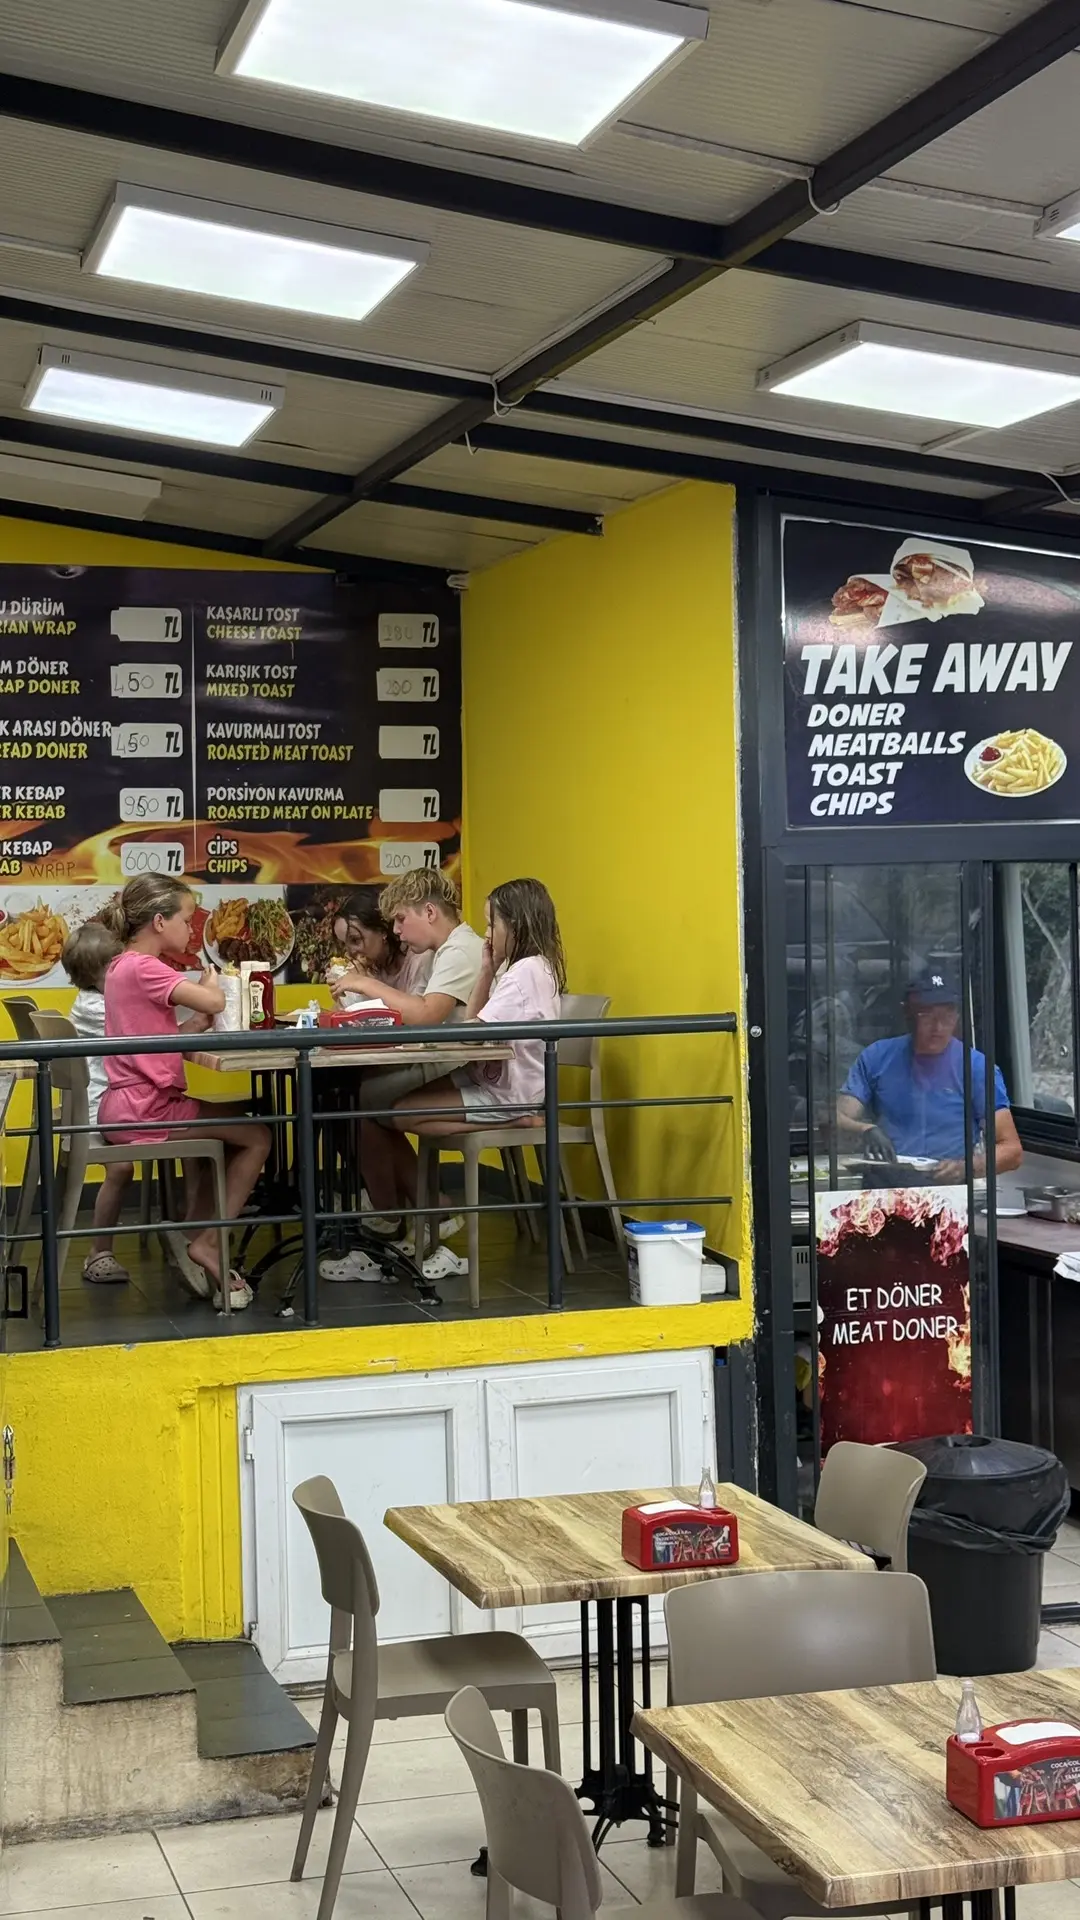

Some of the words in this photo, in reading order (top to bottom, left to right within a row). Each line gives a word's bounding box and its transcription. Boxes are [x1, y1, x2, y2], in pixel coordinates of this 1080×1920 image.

[10, 597, 65, 616] DÜRÜM
[207, 606, 263, 624] KAŞARLI
[266, 607, 300, 621] TOST
[32, 621, 77, 635] WRAP
[164, 616, 179, 638] TL
[207, 625, 256, 639] CHEESE
[260, 626, 302, 640] TOAST
[422, 622, 437, 643] TL
[16, 656, 69, 675] DÖNER
[206, 664, 260, 682] KARIŞIK
[263, 665, 298, 679] TOST
[800, 643, 929, 696] TAKE
[932, 641, 1074, 693] AWAY
[28, 679, 81, 694] DONER
[165, 672, 180, 694] TL
[206, 683, 250, 697] MIXED
[252, 683, 295, 698] TOAST
[422, 676, 437, 698] TL
[807, 702, 906, 728] DONER
[12, 720, 57, 737] ARASI
[60, 716, 112, 738] DÖNER
[206, 722, 285, 739] KAVURMALI
[287, 723, 322, 740] TOST
[0, 742, 33, 759] EAD
[35, 742, 88, 759] DONER
[165, 731, 181, 754] TL
[206, 743, 271, 761] ROASTED
[272, 745, 310, 761] MEAT
[310, 744, 354, 762] TOAST
[423, 734, 437, 755] TL
[807, 731, 967, 758] MEATBALLS
[810, 762, 904, 787] TOAST
[15, 786, 66, 801] KEBAP
[206, 782, 276, 801] PORSİYON
[278, 787, 345, 801] KAVURMA
[15, 805, 66, 819] KEBAB
[166, 796, 182, 818] TL
[207, 805, 271, 820] ROASTED
[273, 805, 310, 820] MEAT
[310, 805, 331, 820] ON
[334, 806, 374, 820] PLATE
[423, 797, 437, 818] TL
[809, 791, 896, 818] CHIPS
[2, 841, 53, 856] KEBAP
[207, 835, 238, 855] CİPS
[125, 849, 161, 872] 600
[167, 850, 182, 872] TL
[207, 859, 248, 873] CHIPS
[385, 853, 412, 869] 200
[423, 849, 438, 872] TL
[29, 863, 76, 880] WRAP
[846, 1288, 872, 1311] ET
[876, 1282, 943, 1310] DÖNER
[832, 1320, 888, 1346] MEAT
[892, 1315, 958, 1342] DONER
